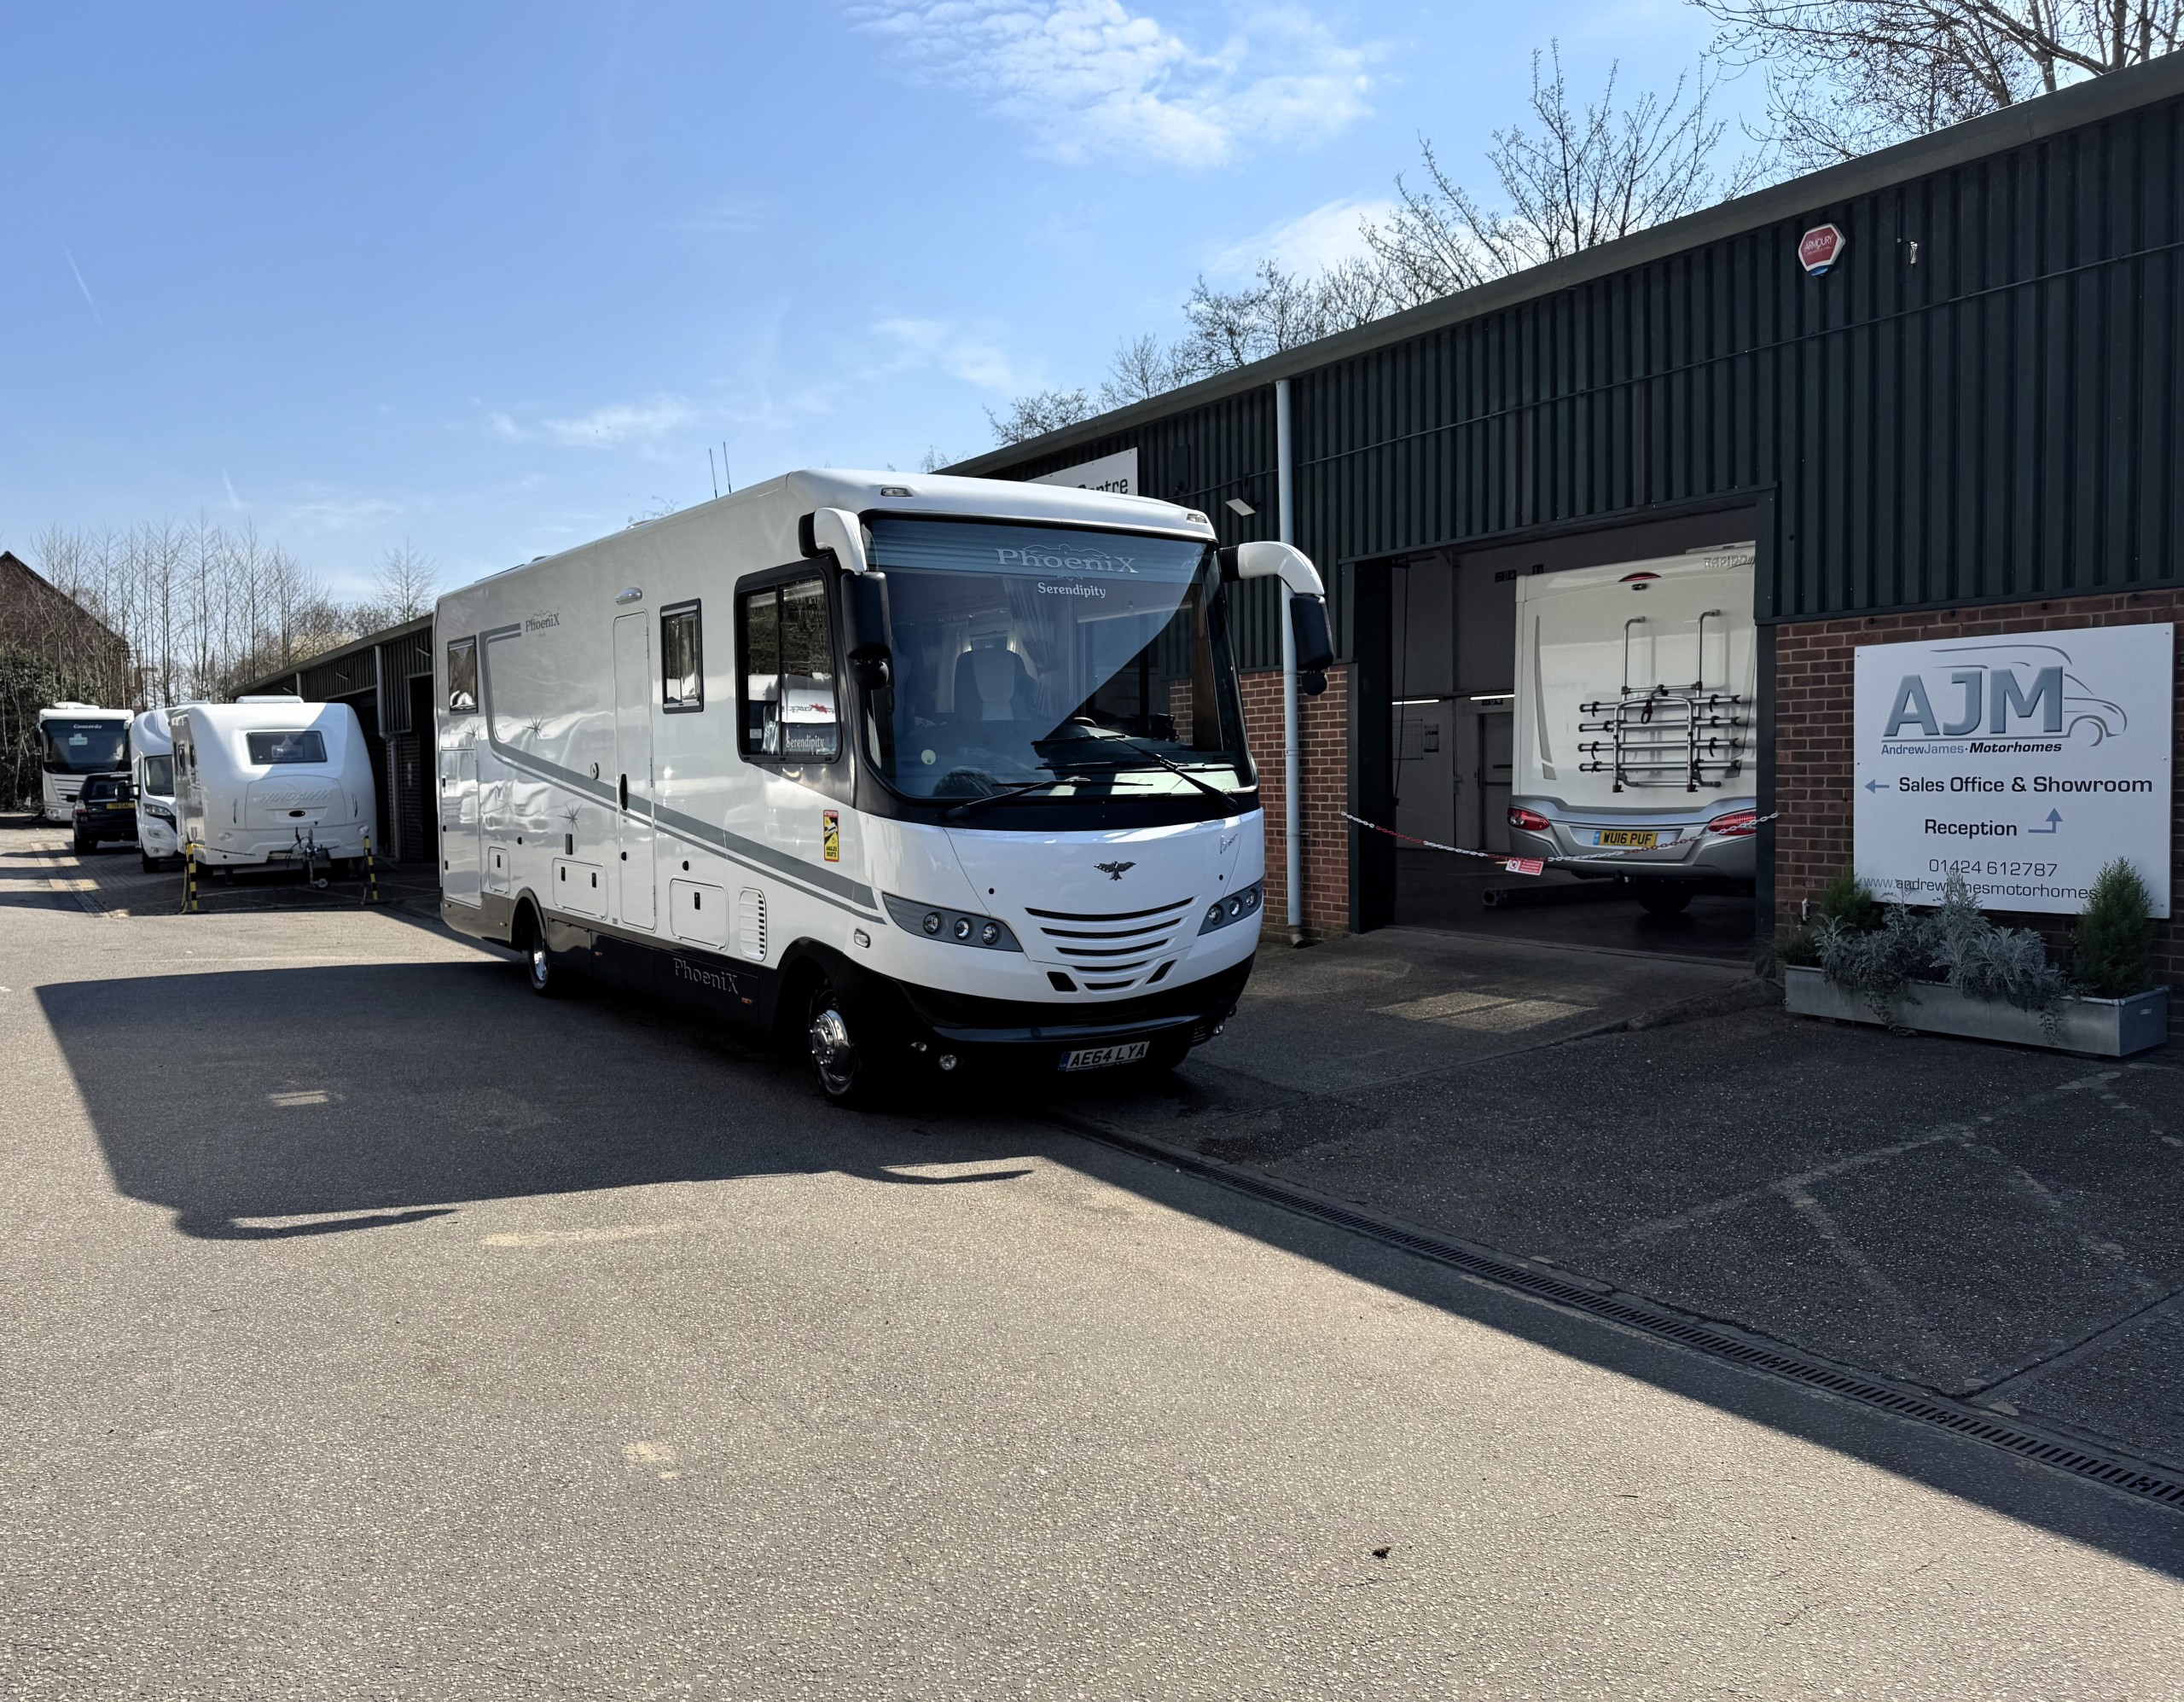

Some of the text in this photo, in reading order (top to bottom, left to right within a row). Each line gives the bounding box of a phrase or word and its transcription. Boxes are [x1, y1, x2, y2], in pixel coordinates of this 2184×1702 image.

[1804, 234, 1833, 251] ARMOURY
[995, 548, 1139, 573] PhoeniX
[1037, 582, 1107, 599] Serendipity
[1883, 665, 2063, 737] AJM
[1899, 775, 2152, 793] Sales Office & Showroom
[1925, 819, 2018, 839] Reception
[1629, 833, 1653, 845] PUF
[1929, 859, 2058, 877] 01424 612787
[672, 957, 739, 995] PhoeniX
[1070, 1049, 1112, 1067] AE64
[1114, 1043, 1146, 1061] LYA
